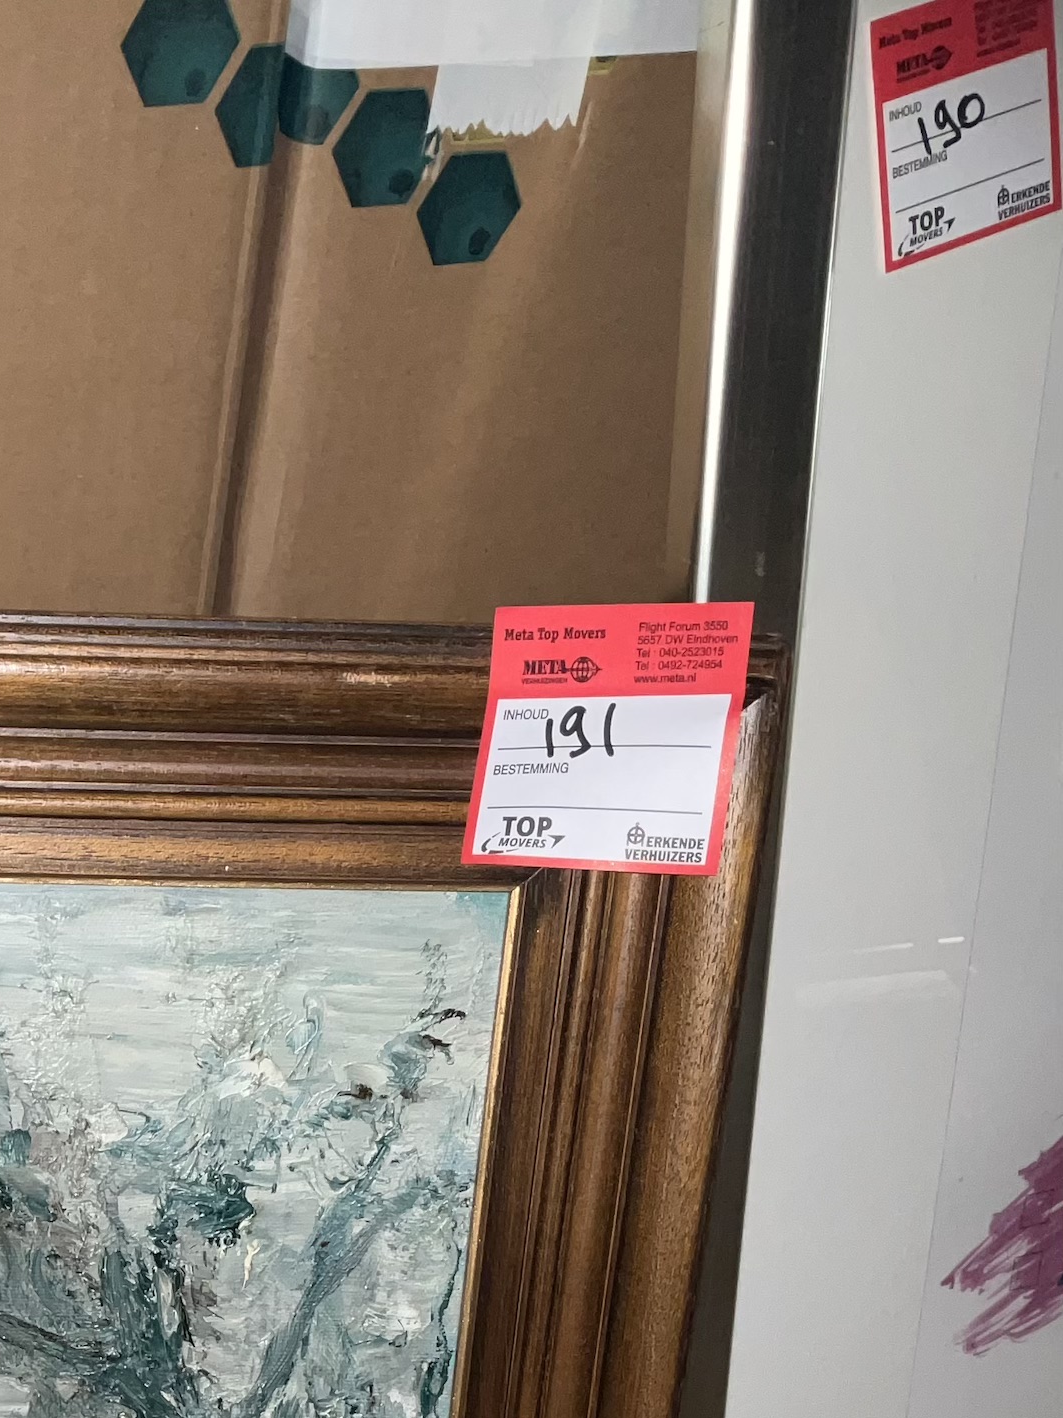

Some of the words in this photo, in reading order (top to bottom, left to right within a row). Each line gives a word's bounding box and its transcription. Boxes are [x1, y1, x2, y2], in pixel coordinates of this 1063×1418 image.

[889, 101, 922, 122] INHOUD
[918, 93, 985, 156] 190
[892, 150, 948, 179] BESTEMMING
[1011, 180, 1050, 204] ERKENDE
[998, 193, 1050, 221] VERHUIZERS
[908, 206, 945, 235] TOP
[909, 226, 943, 247] MOVERS
[504, 628, 534, 641] Meta
[537, 627, 559, 643] Top
[563, 627, 606, 640] Movers
[639, 622, 666, 634] Flight
[668, 621, 701, 632] Forum
[703, 620, 729, 631] 3550
[637, 635, 662, 645] 5657
[665, 634, 684, 645] DW
[686, 634, 739, 645] Eindhoven
[522, 659, 567, 675] META
[633, 672, 697, 684] www.meta.nl
[503, 709, 549, 721] INHOUD
[546, 703, 617, 759] 191
[493, 763, 570, 776] BESTEMMING
[503, 816, 553, 838] TOP
[498, 837, 547, 849] MOVERS
[647, 835, 705, 850] ERKENDE
[625, 848, 703, 864] VERHUIZERS
